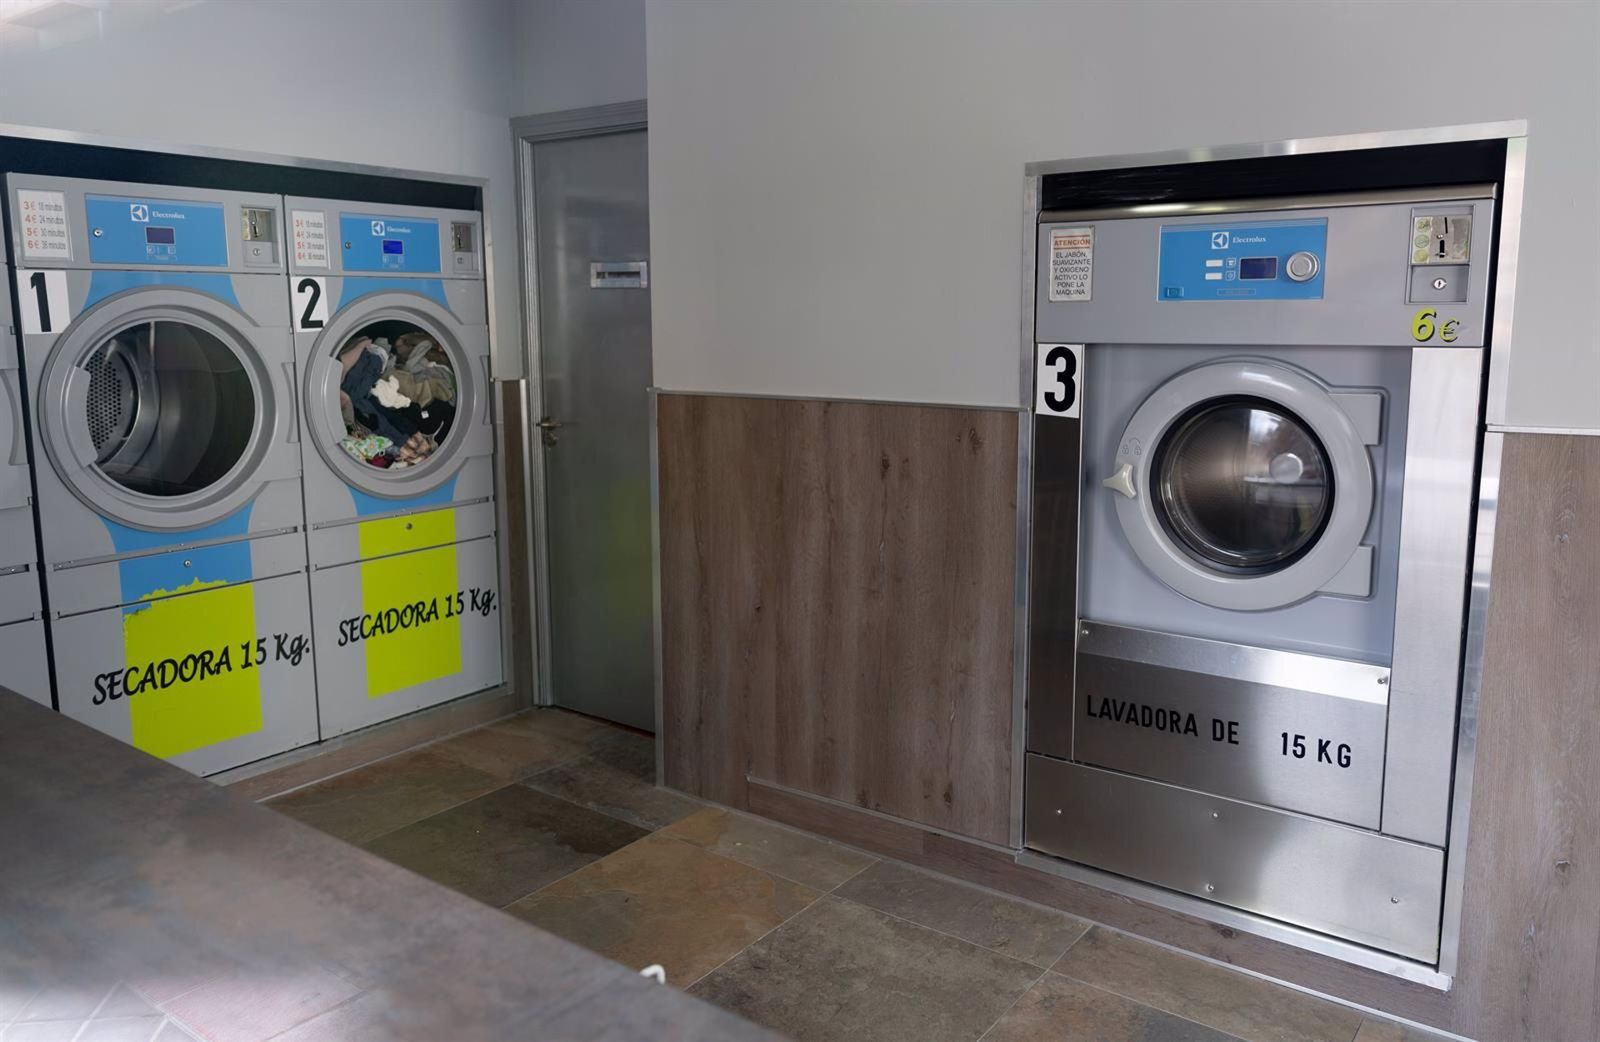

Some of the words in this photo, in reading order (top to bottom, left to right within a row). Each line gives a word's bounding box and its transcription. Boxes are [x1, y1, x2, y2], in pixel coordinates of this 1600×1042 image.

[152, 211, 185, 219] Electrolux
[1054, 239, 1091, 247] ATENCIÓN
[1232, 236, 1266, 244] Electrolux
[30, 272, 52, 332] 1
[297, 278, 324, 329] 2
[1044, 346, 1077, 412] 3
[337, 598, 440, 647] SECADORA
[444, 592, 465, 618] 15
[468, 587, 497, 617] Kg.
[92, 644, 233, 706] SECADORA
[240, 638, 267, 678] 15
[274, 632, 311, 666] Kg.
[1087, 694, 1198, 738] LAVADORA
[1212, 718, 1240, 745] DE
[1281, 732, 1306, 758] 15
[1317, 738, 1352, 769] KG
